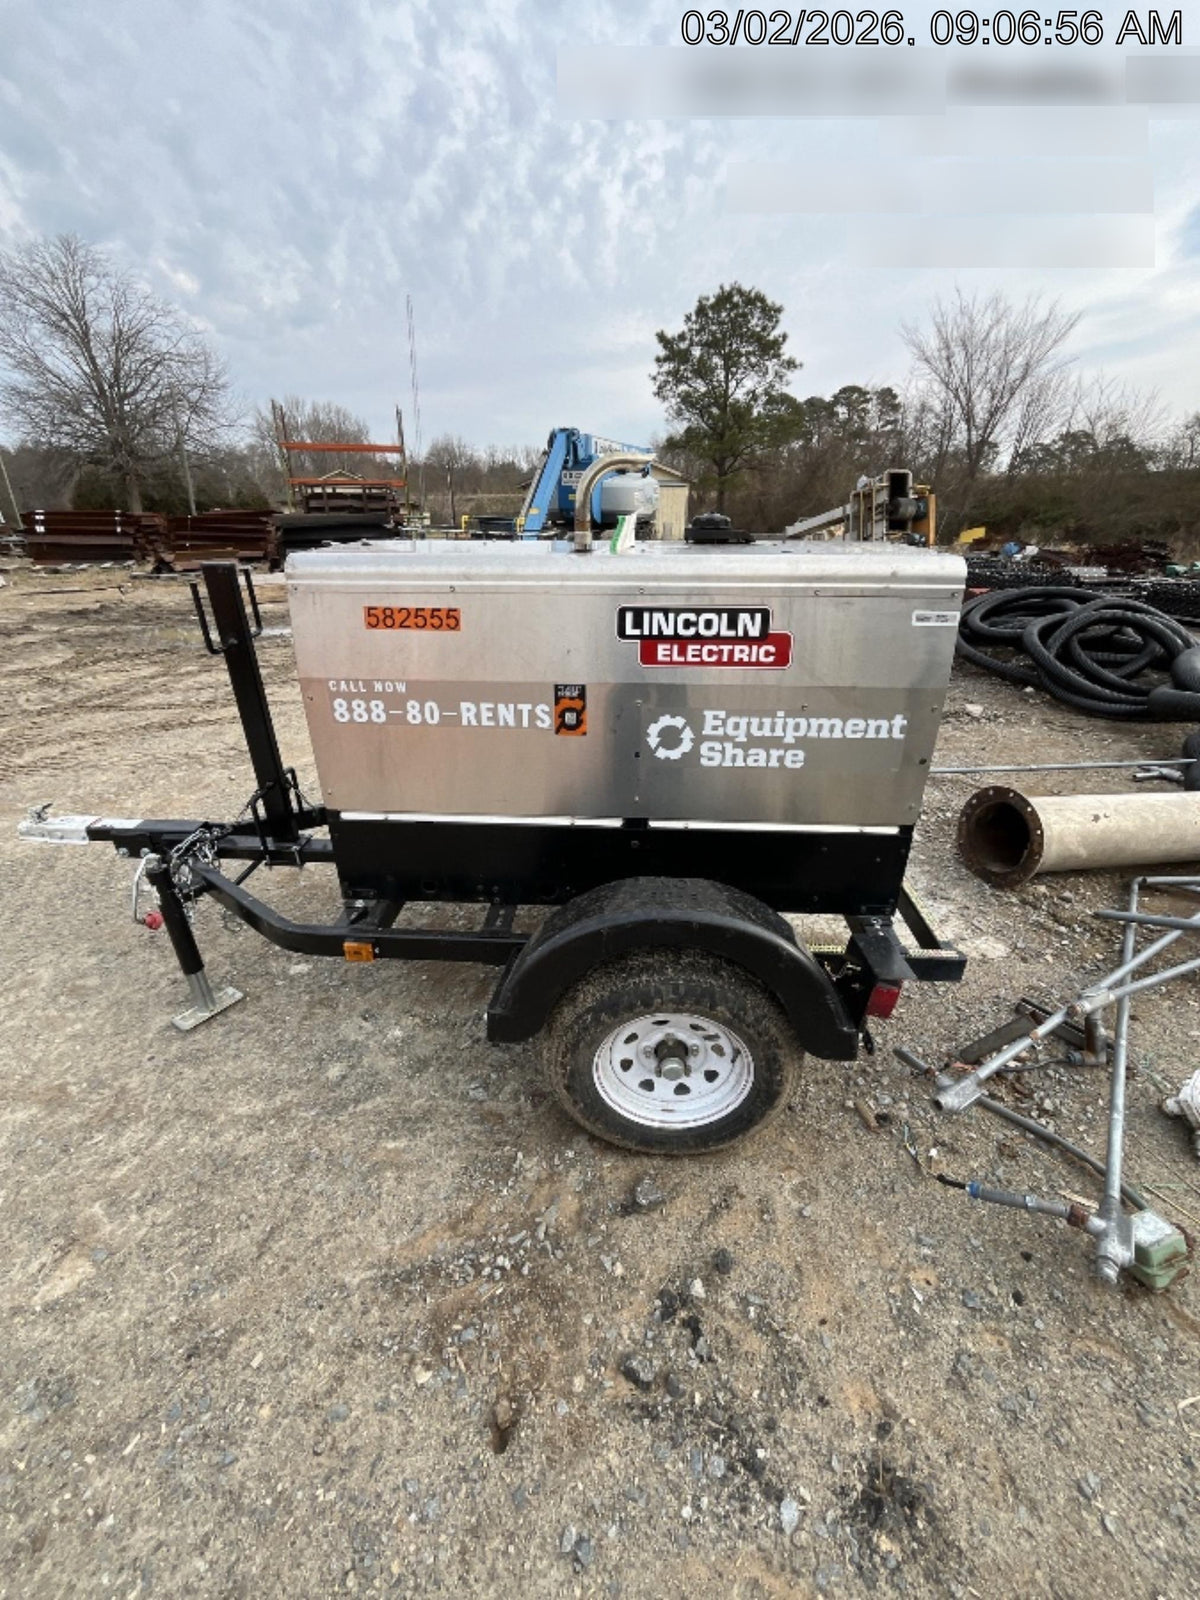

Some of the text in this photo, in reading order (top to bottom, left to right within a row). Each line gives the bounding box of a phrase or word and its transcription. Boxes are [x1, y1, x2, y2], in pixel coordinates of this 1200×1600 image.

[366, 607, 460, 630] 582555
[624, 610, 762, 638] LINCOLN
[656, 643, 776, 664] ELECTRIC
[328, 680, 406, 694] CALL NOW
[333, 698, 551, 728] 888-80-RENTS
[702, 709, 907, 744] Equipment
[700, 741, 805, 769] Share
